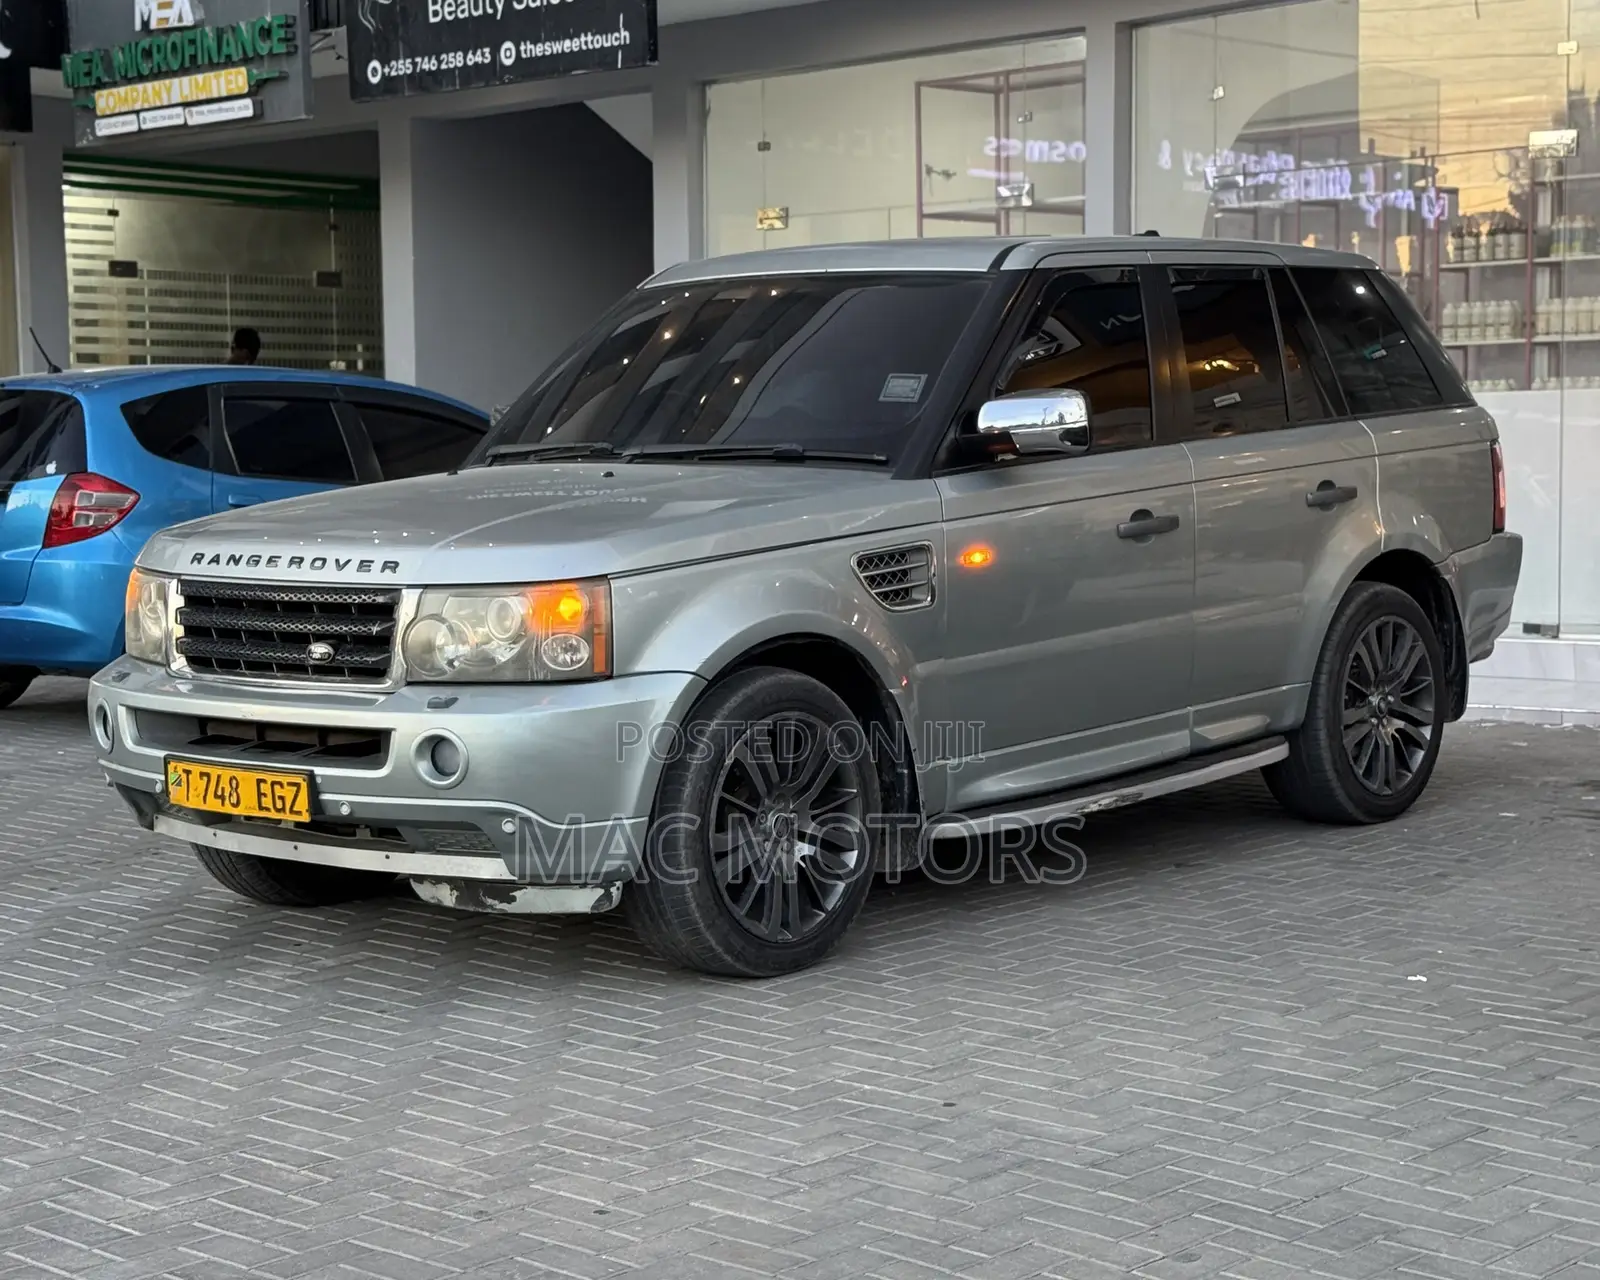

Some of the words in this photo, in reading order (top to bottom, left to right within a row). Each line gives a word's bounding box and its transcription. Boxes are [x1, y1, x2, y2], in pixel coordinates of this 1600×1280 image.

[427, 0, 506, 24] Beauty
[62, 49, 107, 88] MEA
[112, 14, 290, 79] MICROFINANCE
[383, 56, 413, 77] +255
[416, 54, 438, 71] 746
[440, 51, 464, 69] 258
[466, 47, 491, 65] 643
[519, 27, 631, 60] thesweettouch
[95, 79, 173, 115] COMPANY
[179, 67, 249, 100] LIMITED
[182, 768, 193, 802] T
[198, 771, 242, 809] 748
[255, 778, 304, 817] EGZ
